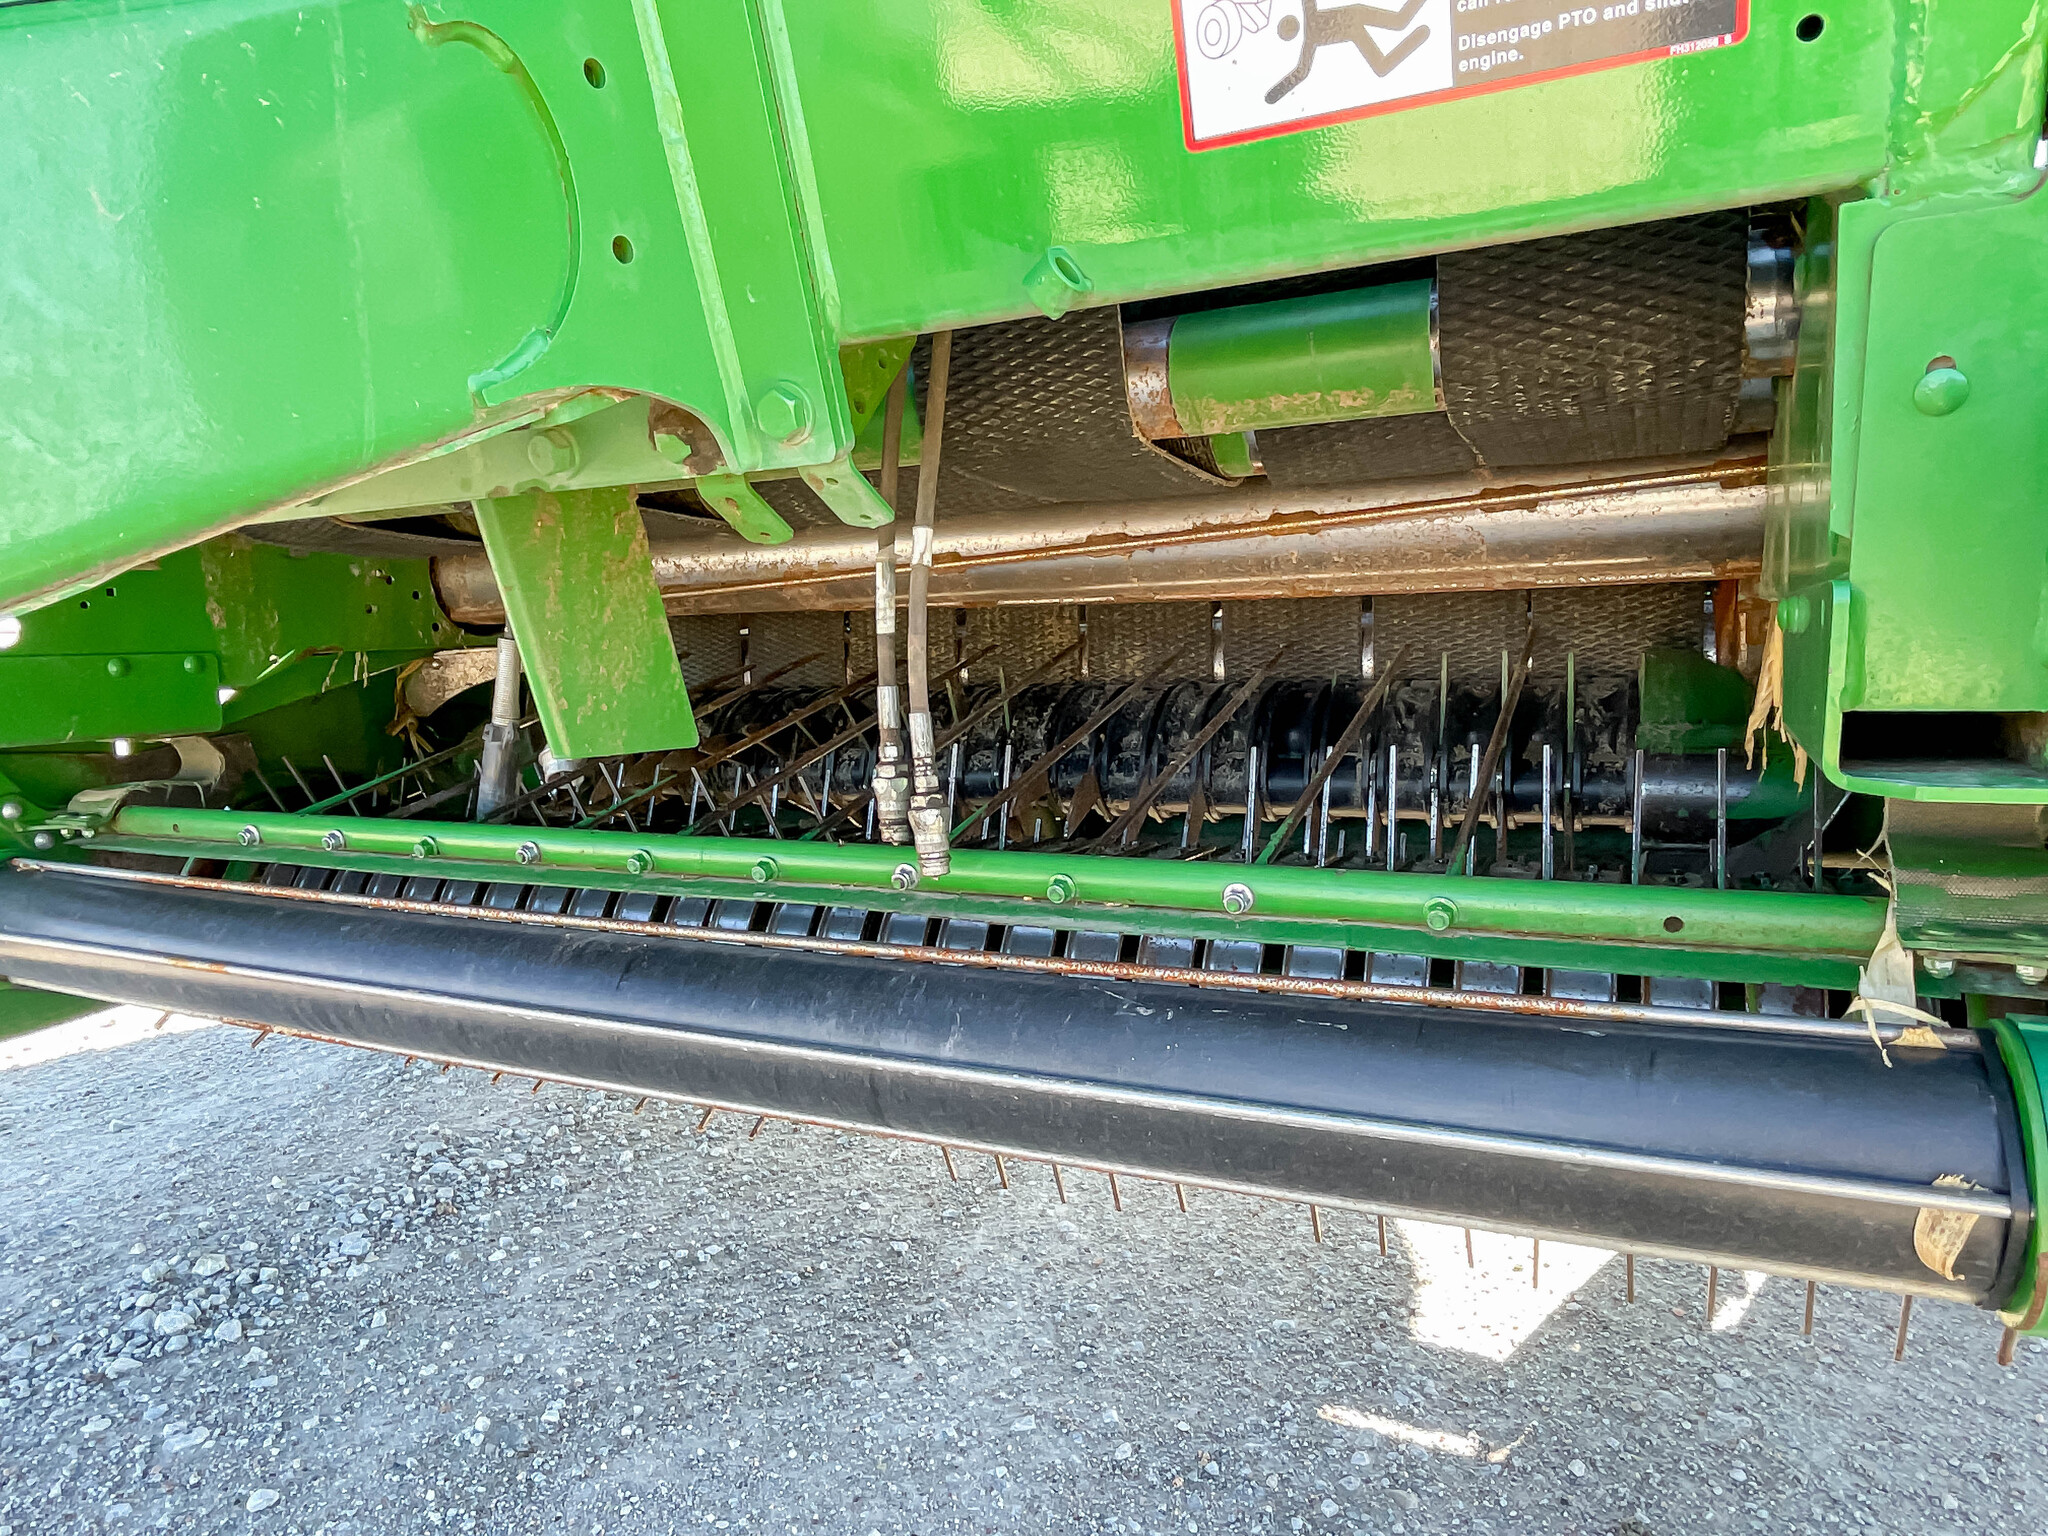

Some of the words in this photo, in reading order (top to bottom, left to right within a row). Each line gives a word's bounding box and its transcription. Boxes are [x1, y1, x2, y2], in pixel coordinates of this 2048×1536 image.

[1458, 20, 1552, 51] Disengage
[1558, 7, 1597, 30] PTO
[1602, 1, 1638, 20] and
[1459, 49, 1524, 72] engine.
